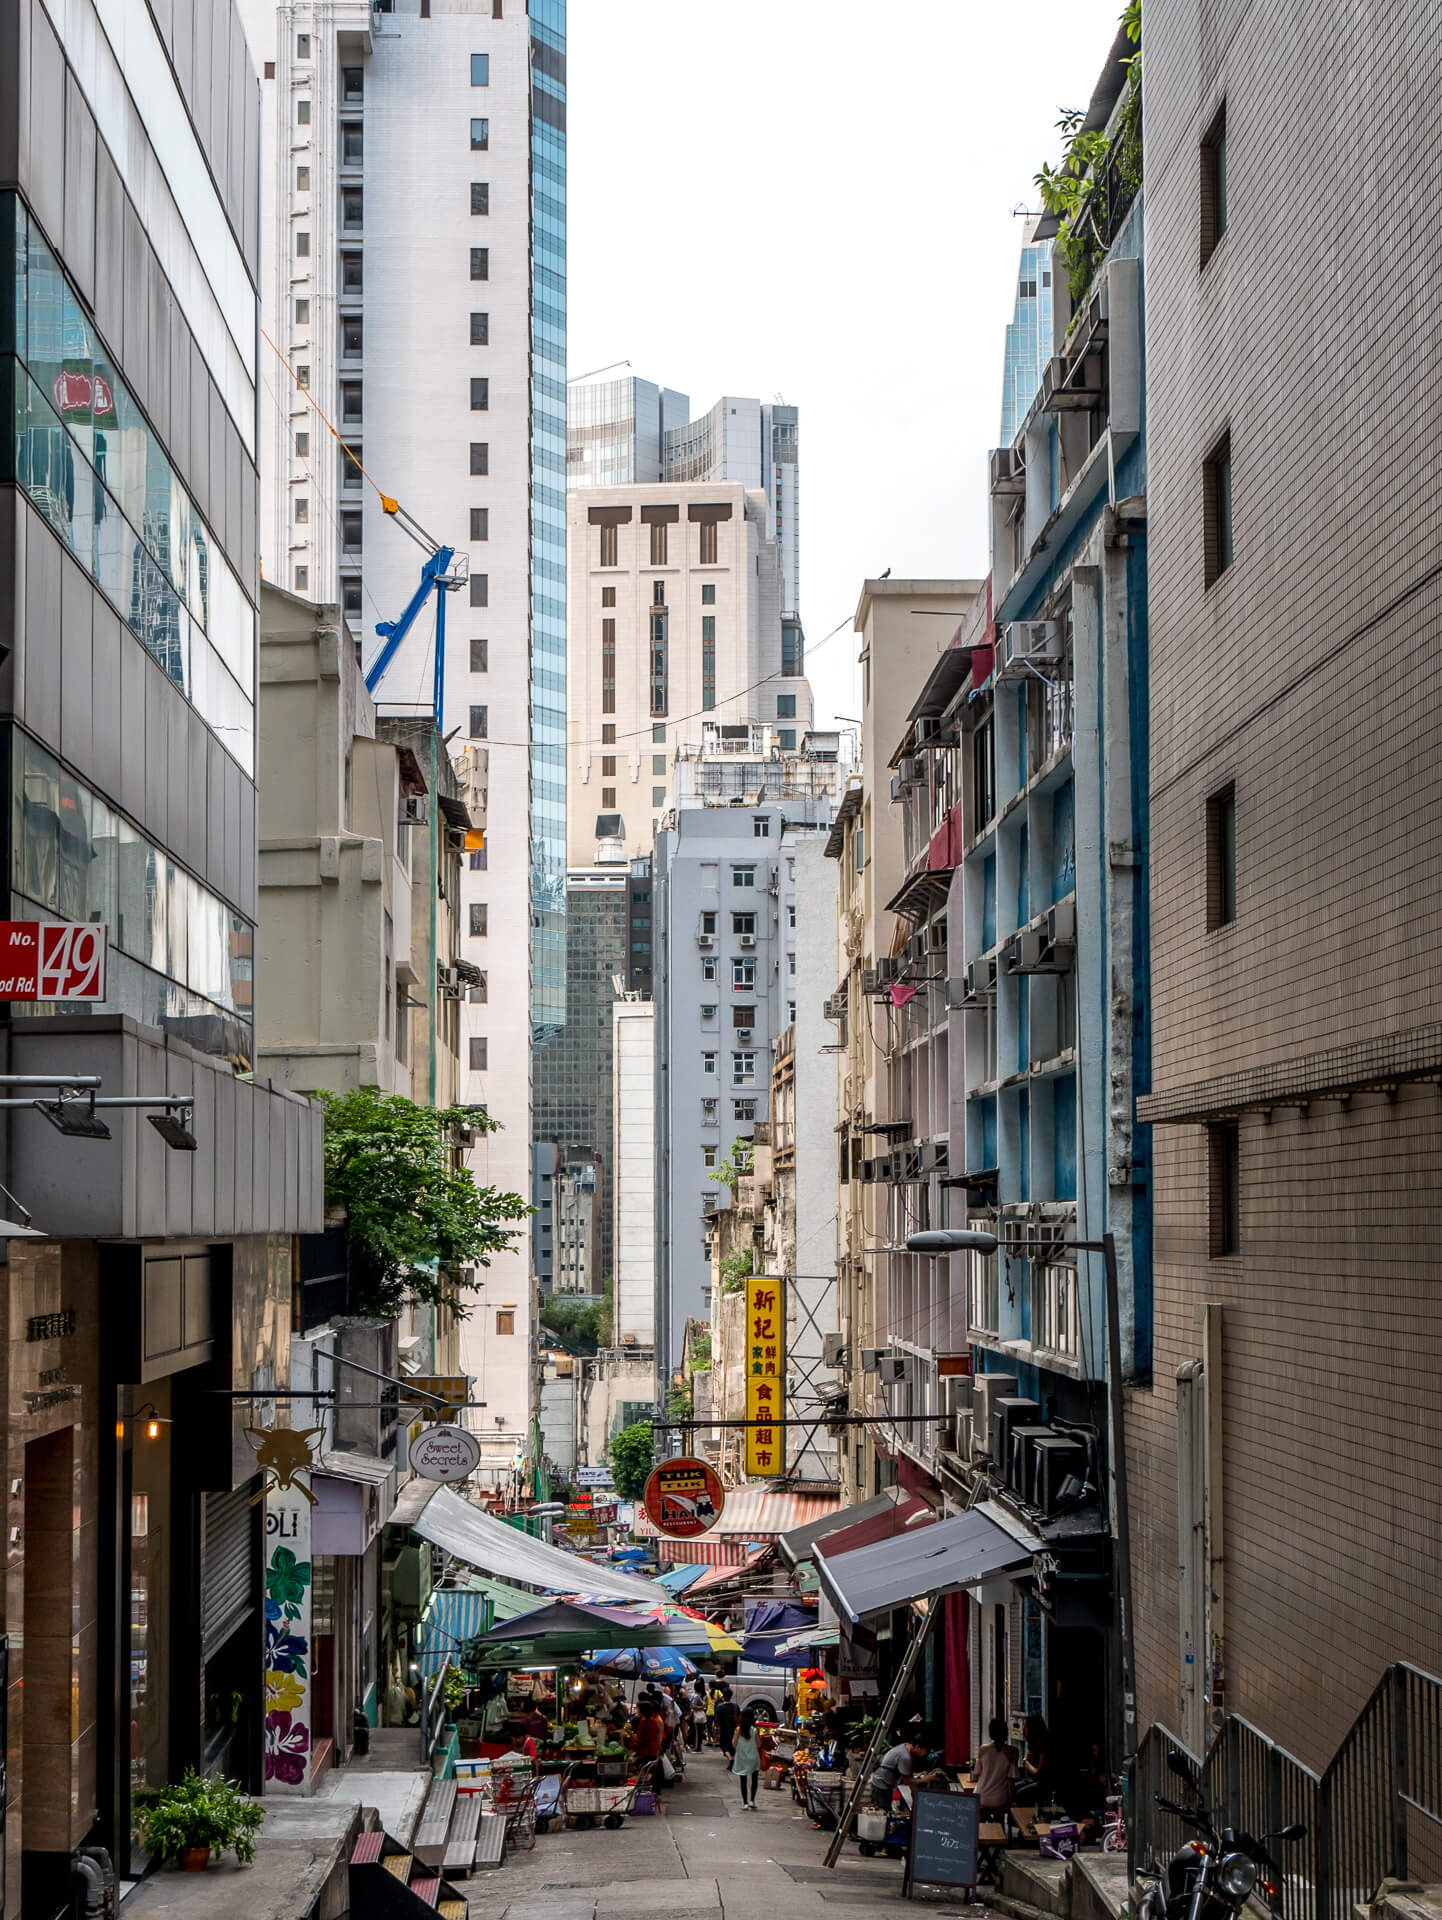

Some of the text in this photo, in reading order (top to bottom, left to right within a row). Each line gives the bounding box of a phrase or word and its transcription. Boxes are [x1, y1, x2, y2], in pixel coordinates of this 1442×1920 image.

[9, 932, 36, 946] No.
[41, 926, 101, 997] 49
[15, 976, 36, 993] Rd.
[753, 1289, 776, 1340] 新記
[755, 1383, 773, 1467] 食品超市
[426, 1441, 463, 1454] Sweet
[420, 1453, 468, 1466] Secrets
[662, 1471, 702, 1479] TUK
[663, 1481, 702, 1489] TUK
